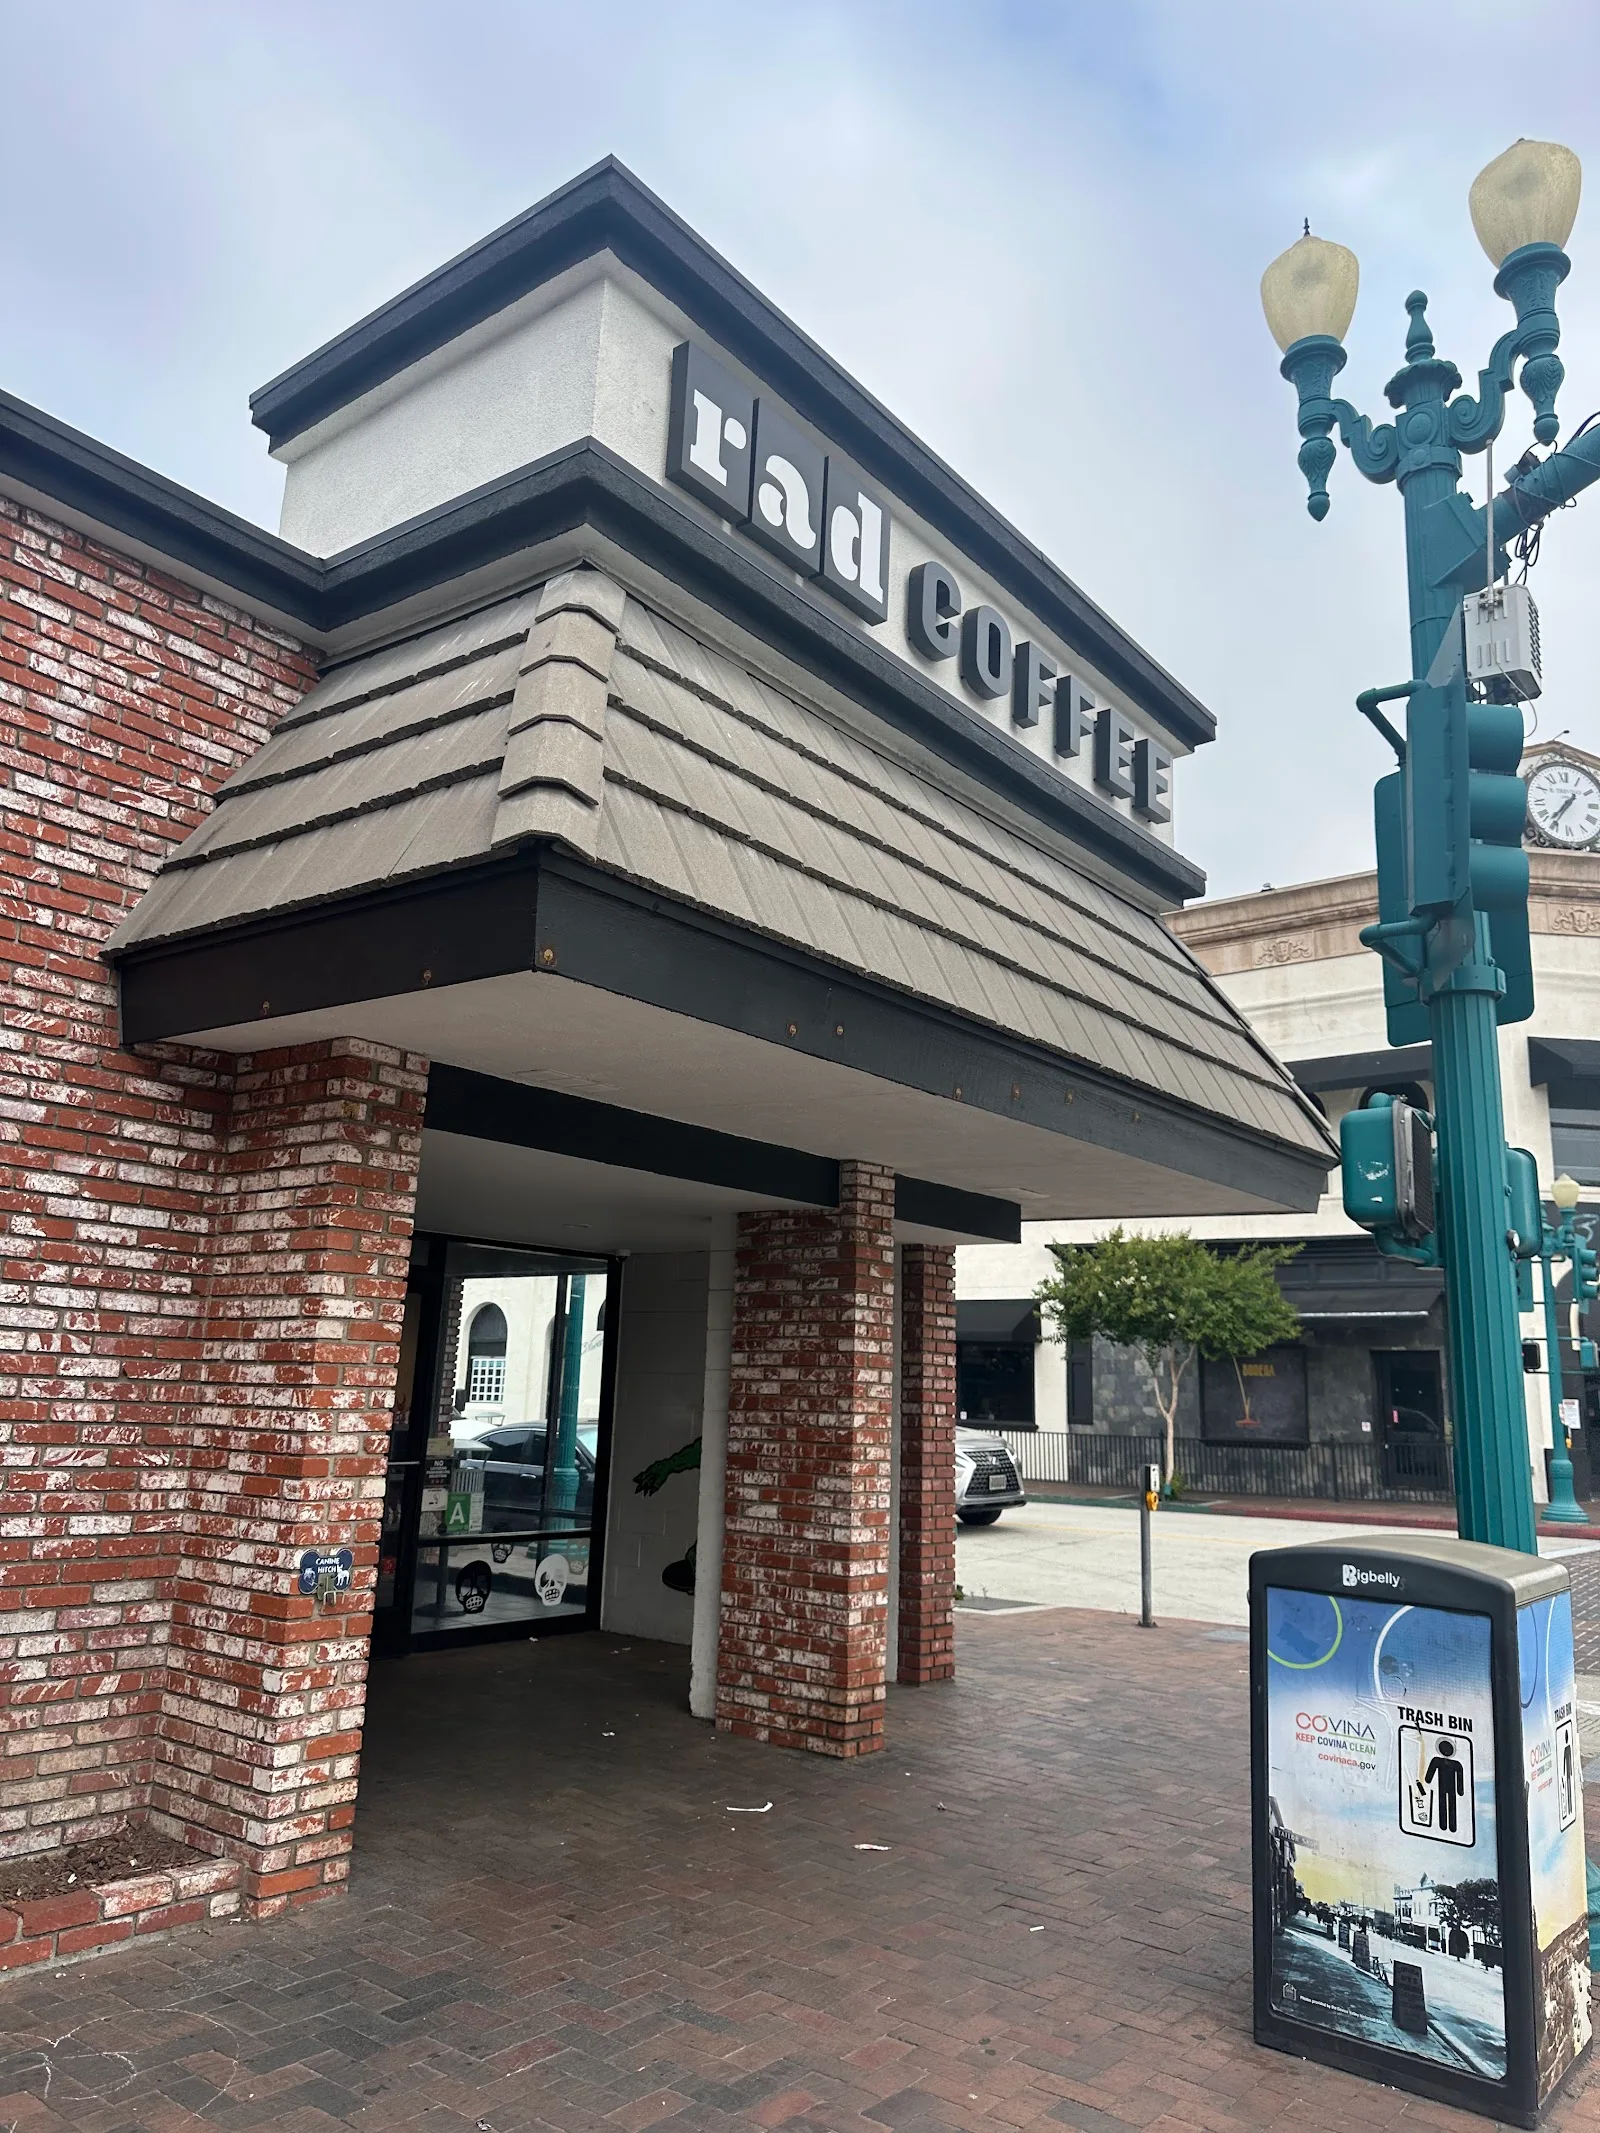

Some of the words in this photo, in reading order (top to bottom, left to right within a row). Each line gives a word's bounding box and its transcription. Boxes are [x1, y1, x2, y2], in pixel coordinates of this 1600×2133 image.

[690, 389, 884, 605] rad
[907, 560, 1171, 825] COFFEE
[449, 1502, 465, 1525] A
[315, 1557, 341, 1565] CANINE
[317, 1565, 336, 1574] HITCH
[1342, 1564, 1400, 1588] Bigbelly
[1296, 1712, 1375, 1740] COVINA
[1397, 1706, 1443, 1727] TRASH
[1448, 1715, 1473, 1732] BIN
[1295, 1732, 1316, 1743] KEEP
[1317, 1736, 1348, 1750] COVINA
[1349, 1742, 1376, 1756] CLEAN
[1318, 1753, 1376, 1770] covinaca.gov
